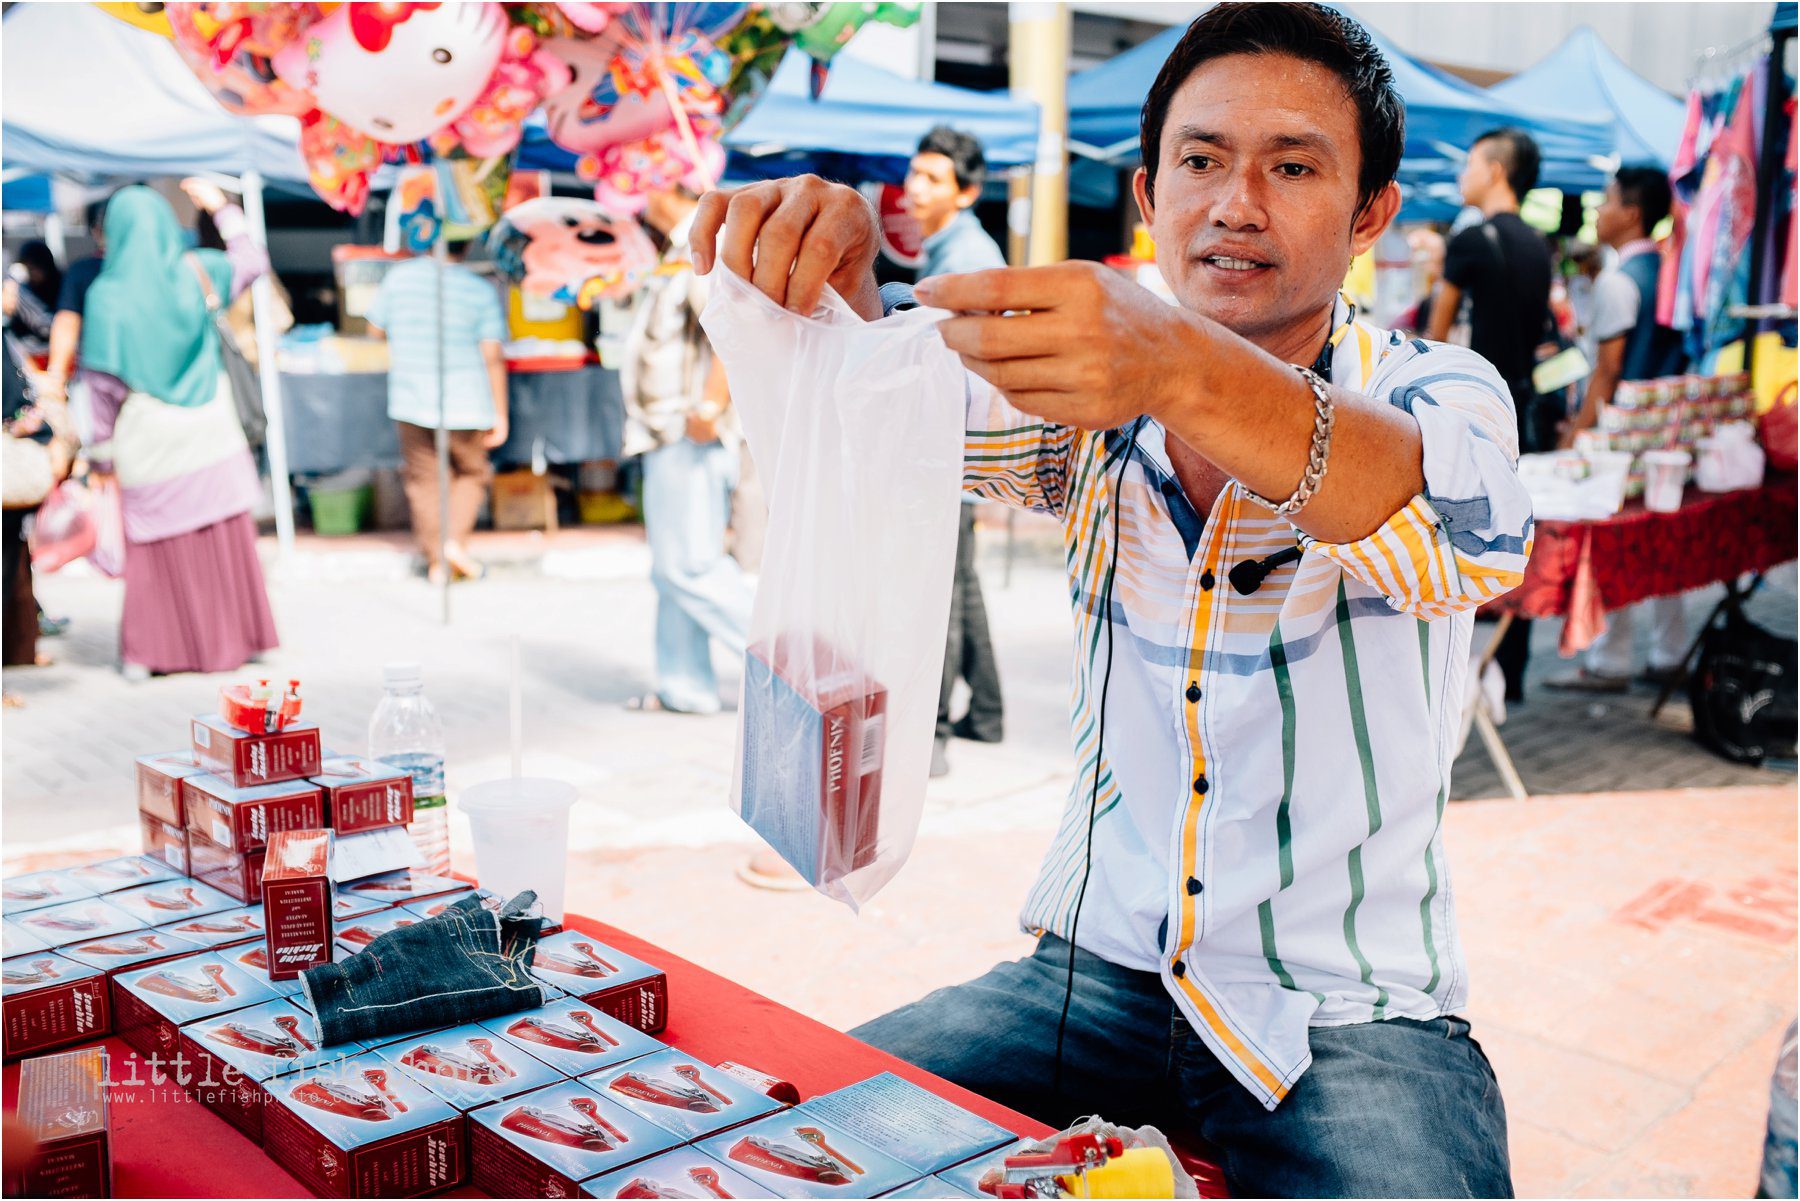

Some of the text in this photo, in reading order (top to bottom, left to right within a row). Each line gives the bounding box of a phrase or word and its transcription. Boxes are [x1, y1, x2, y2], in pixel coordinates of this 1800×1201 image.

[829, 715, 844, 792] PHOENIX
[275, 943, 324, 954] Machine
[279, 952, 318, 964] Sewing
[72, 988, 85, 1034] Machine
[83, 992, 94, 1029] Sewing
[639, 987, 648, 1030] Machine
[647, 991, 656, 1026] Sewing
[427, 1135, 438, 1187] Machine
[438, 1140, 448, 1180] Sewing
